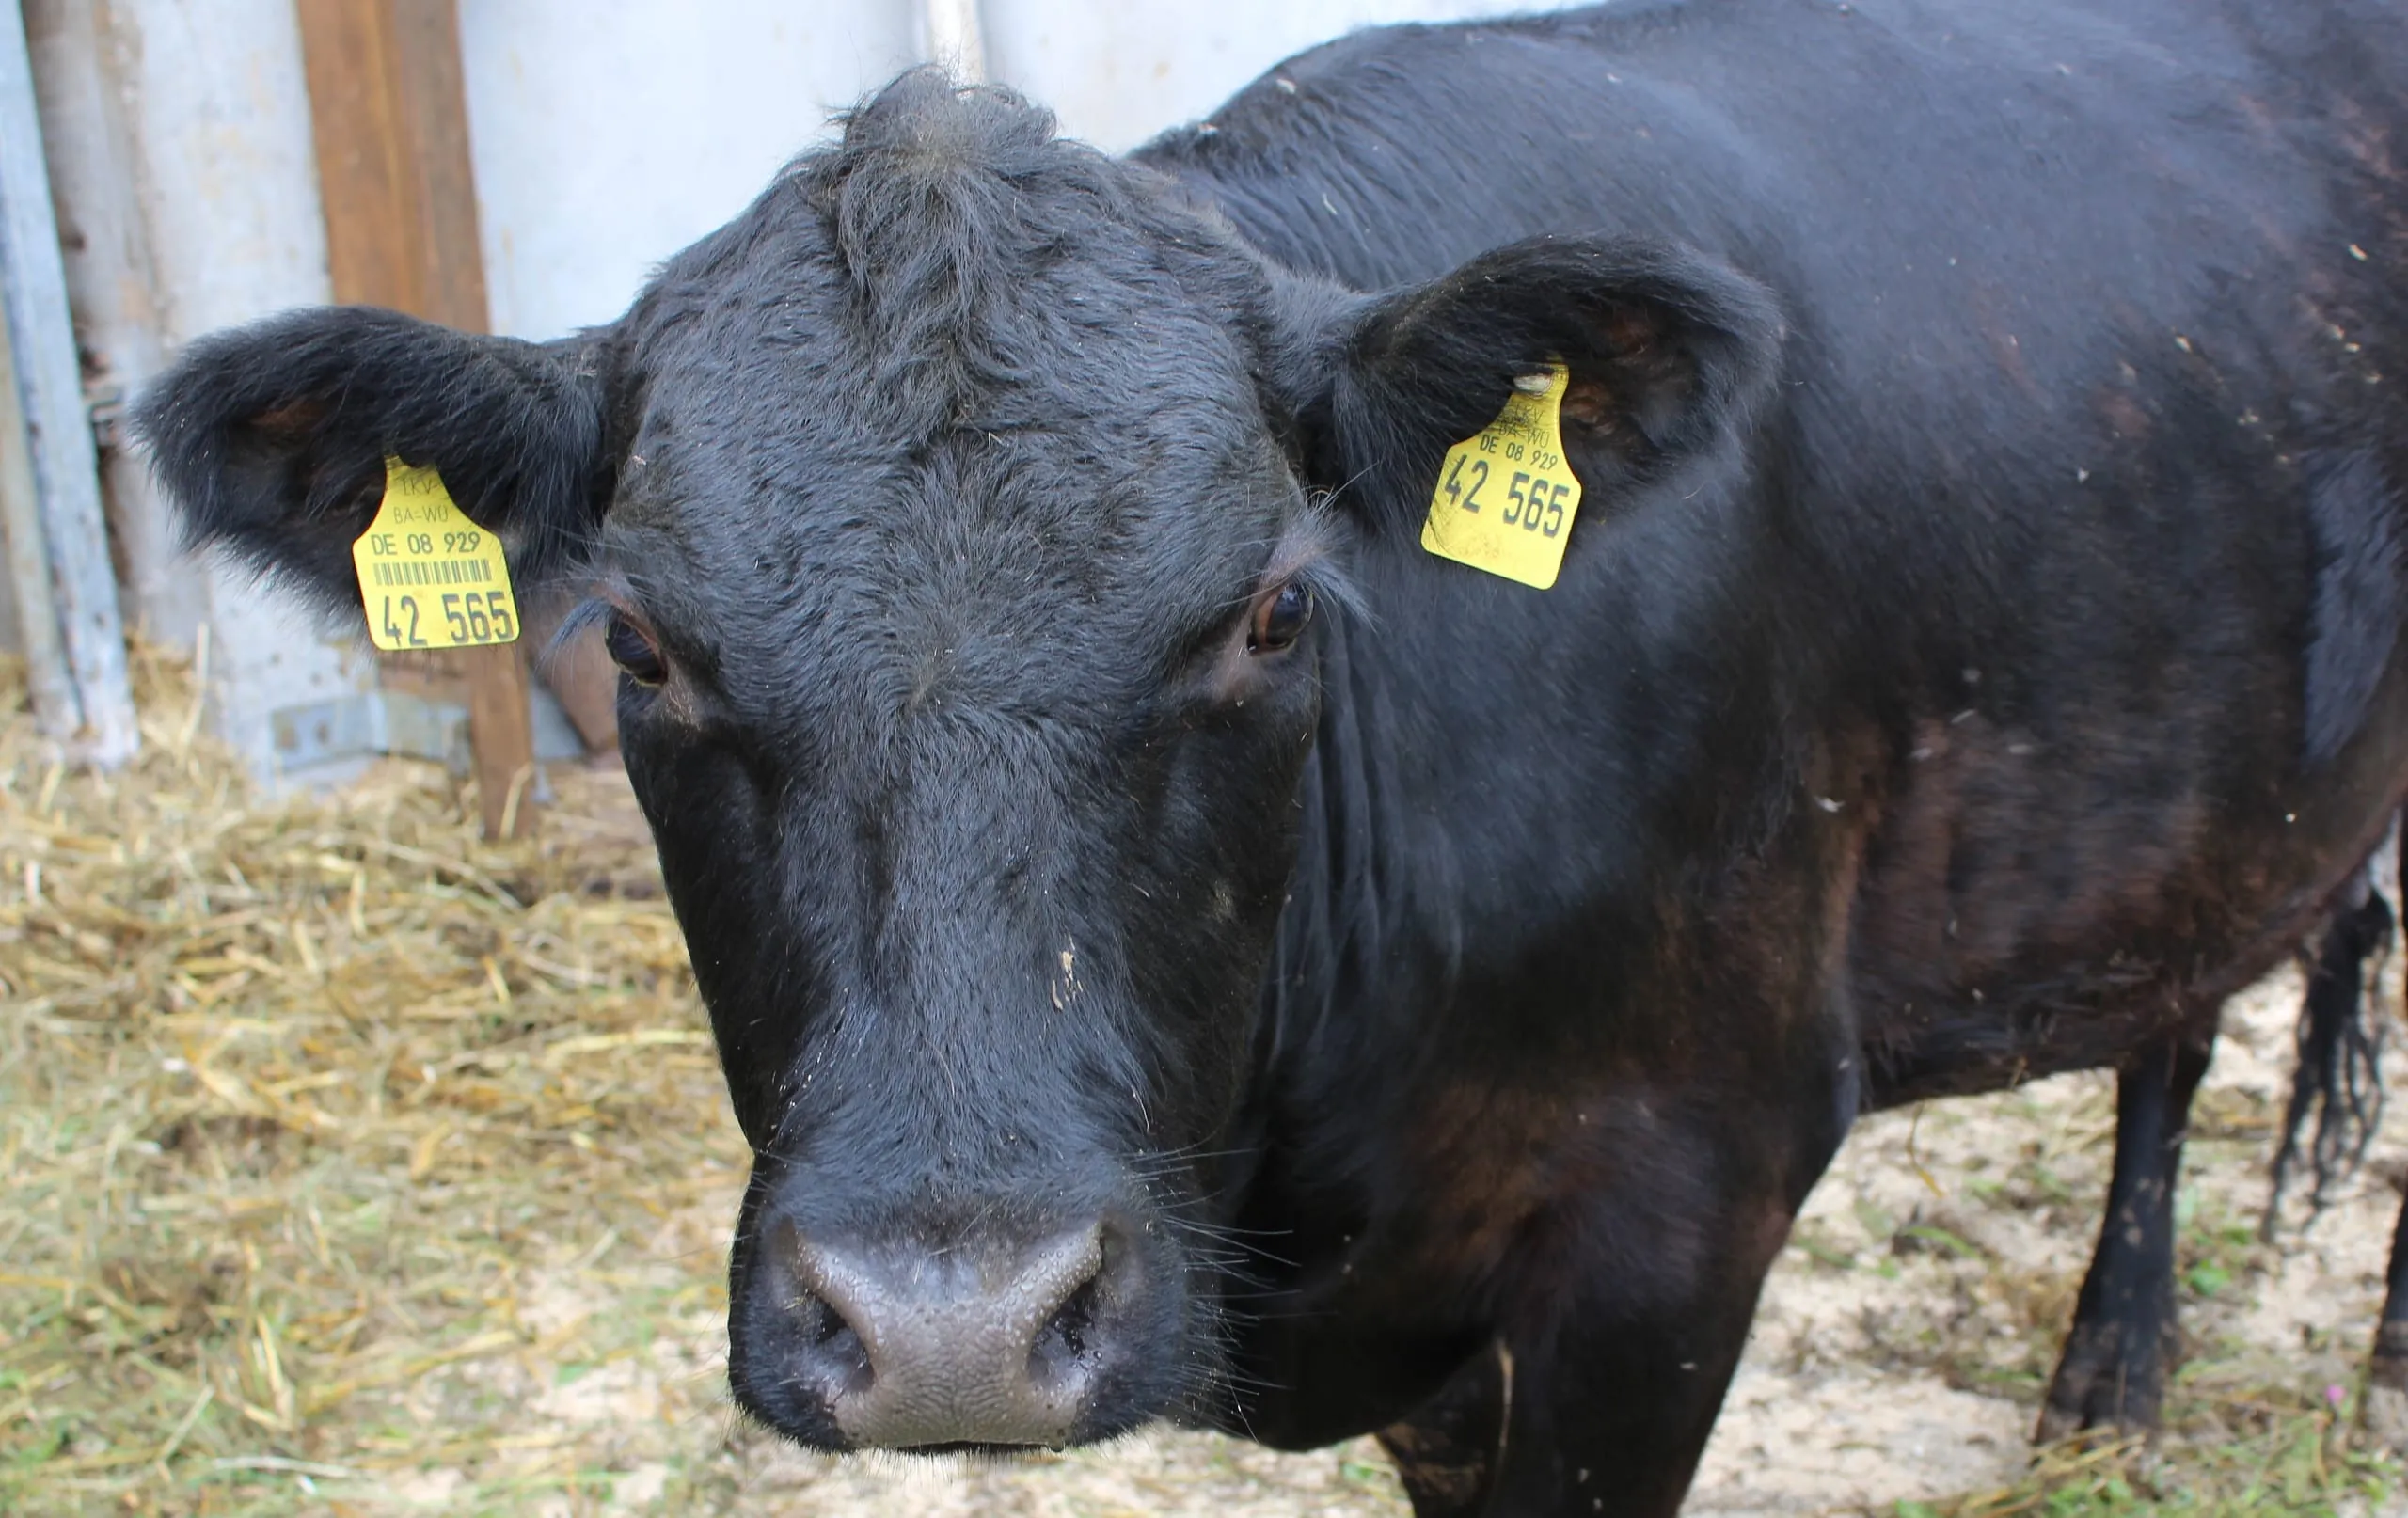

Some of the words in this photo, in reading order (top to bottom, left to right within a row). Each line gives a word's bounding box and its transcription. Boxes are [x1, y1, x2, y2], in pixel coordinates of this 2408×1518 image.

[1480, 435, 1500, 453] DE
[1506, 441, 1524, 461] 08
[1530, 450, 1558, 470] 929
[1444, 454, 1489, 514] 42
[1503, 471, 1570, 538] 565
[371, 533, 397, 555] DE
[407, 533, 433, 554] 08
[443, 531, 481, 553] 929
[383, 595, 428, 647] 42
[441, 591, 514, 644] 565
